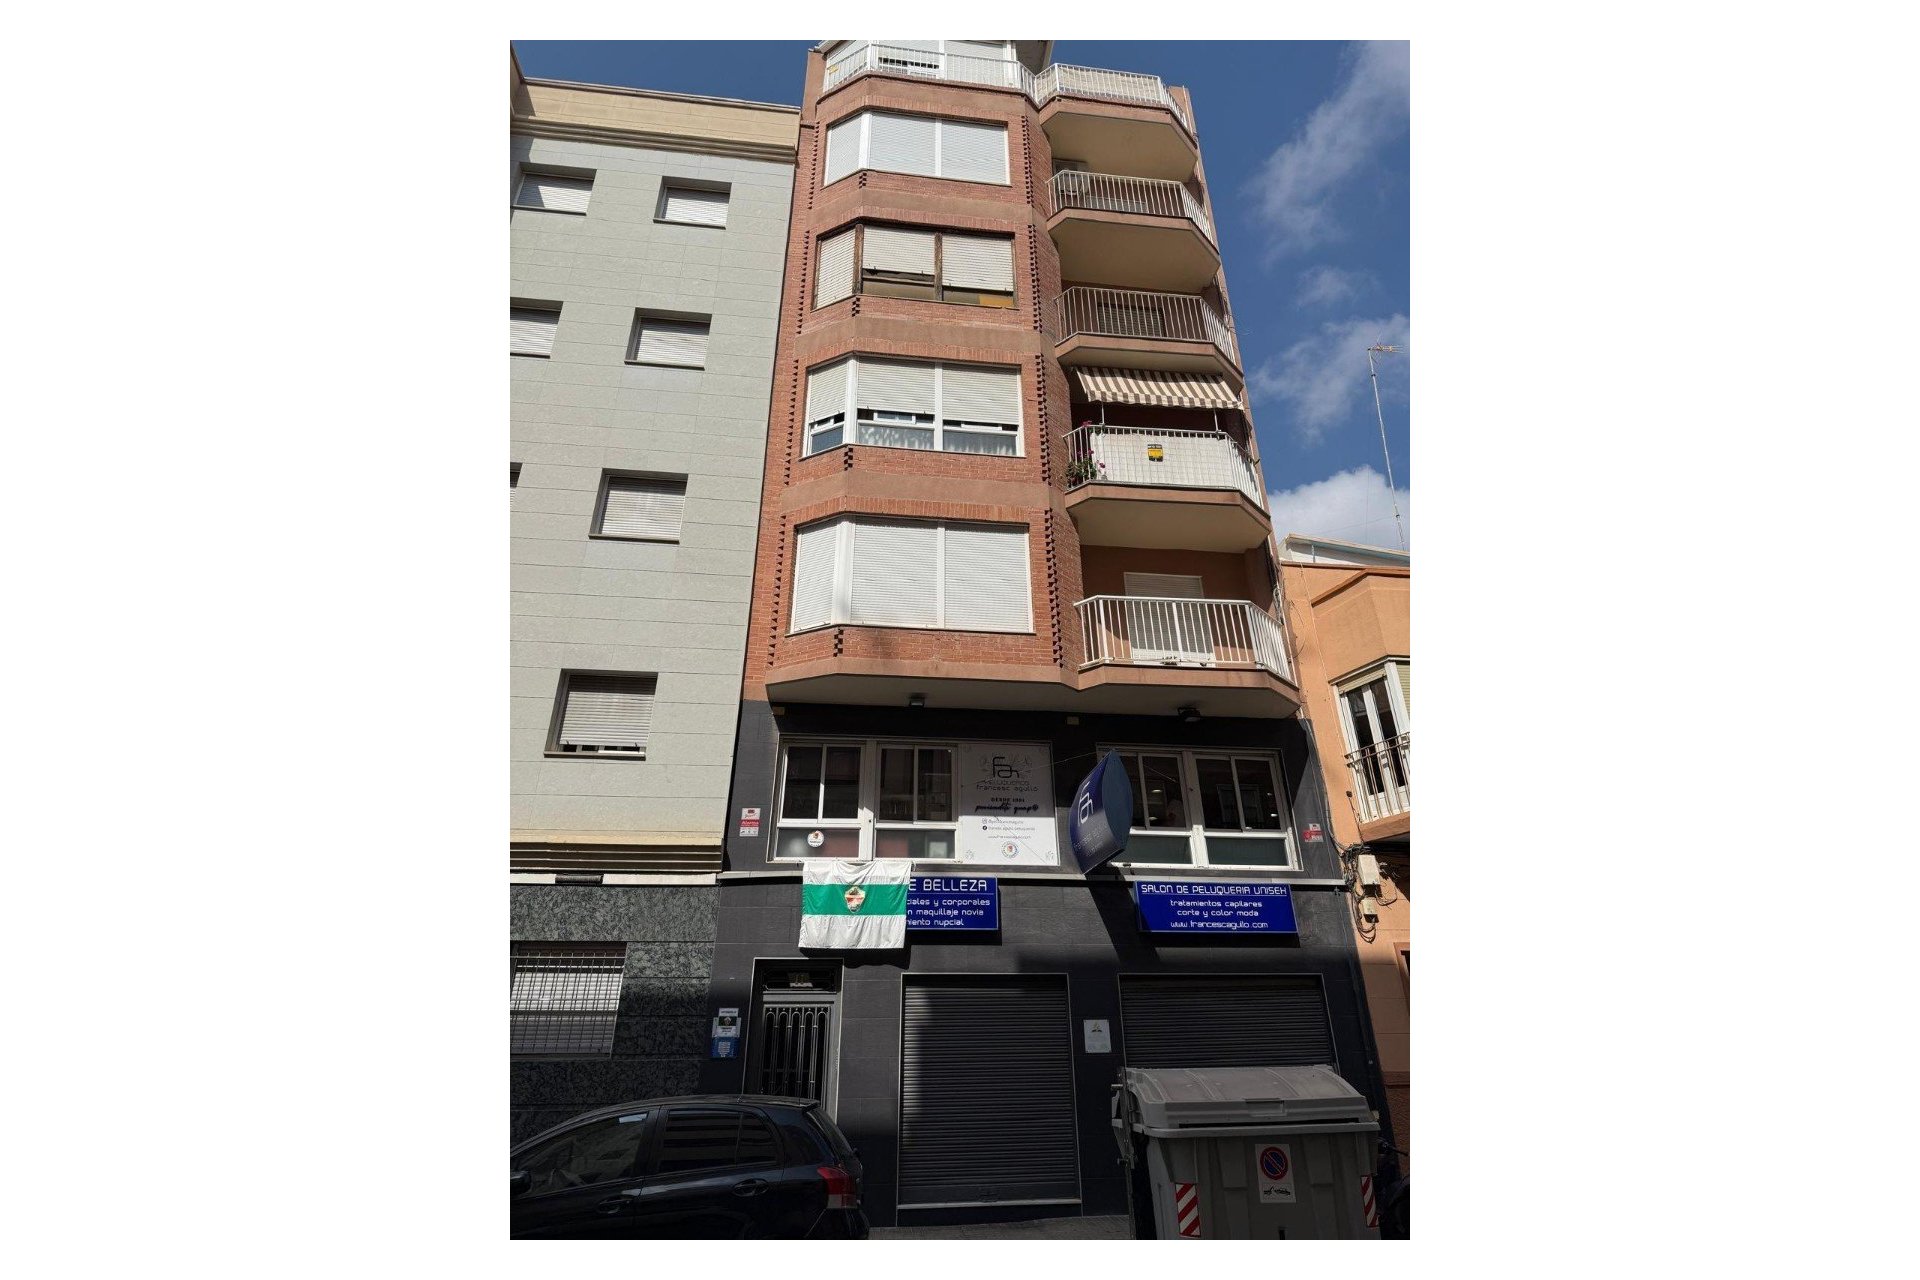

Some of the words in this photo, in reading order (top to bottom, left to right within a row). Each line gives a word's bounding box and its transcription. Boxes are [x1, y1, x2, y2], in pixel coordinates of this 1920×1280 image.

[923, 879, 987, 892] BELLEZA
[1141, 884, 1174, 893] SALON
[1176, 886, 1189, 894] DE
[1192, 886, 1250, 895] PELUQUERIA
[916, 908, 958, 917] maquillaje
[934, 918, 964, 927] nupcial
